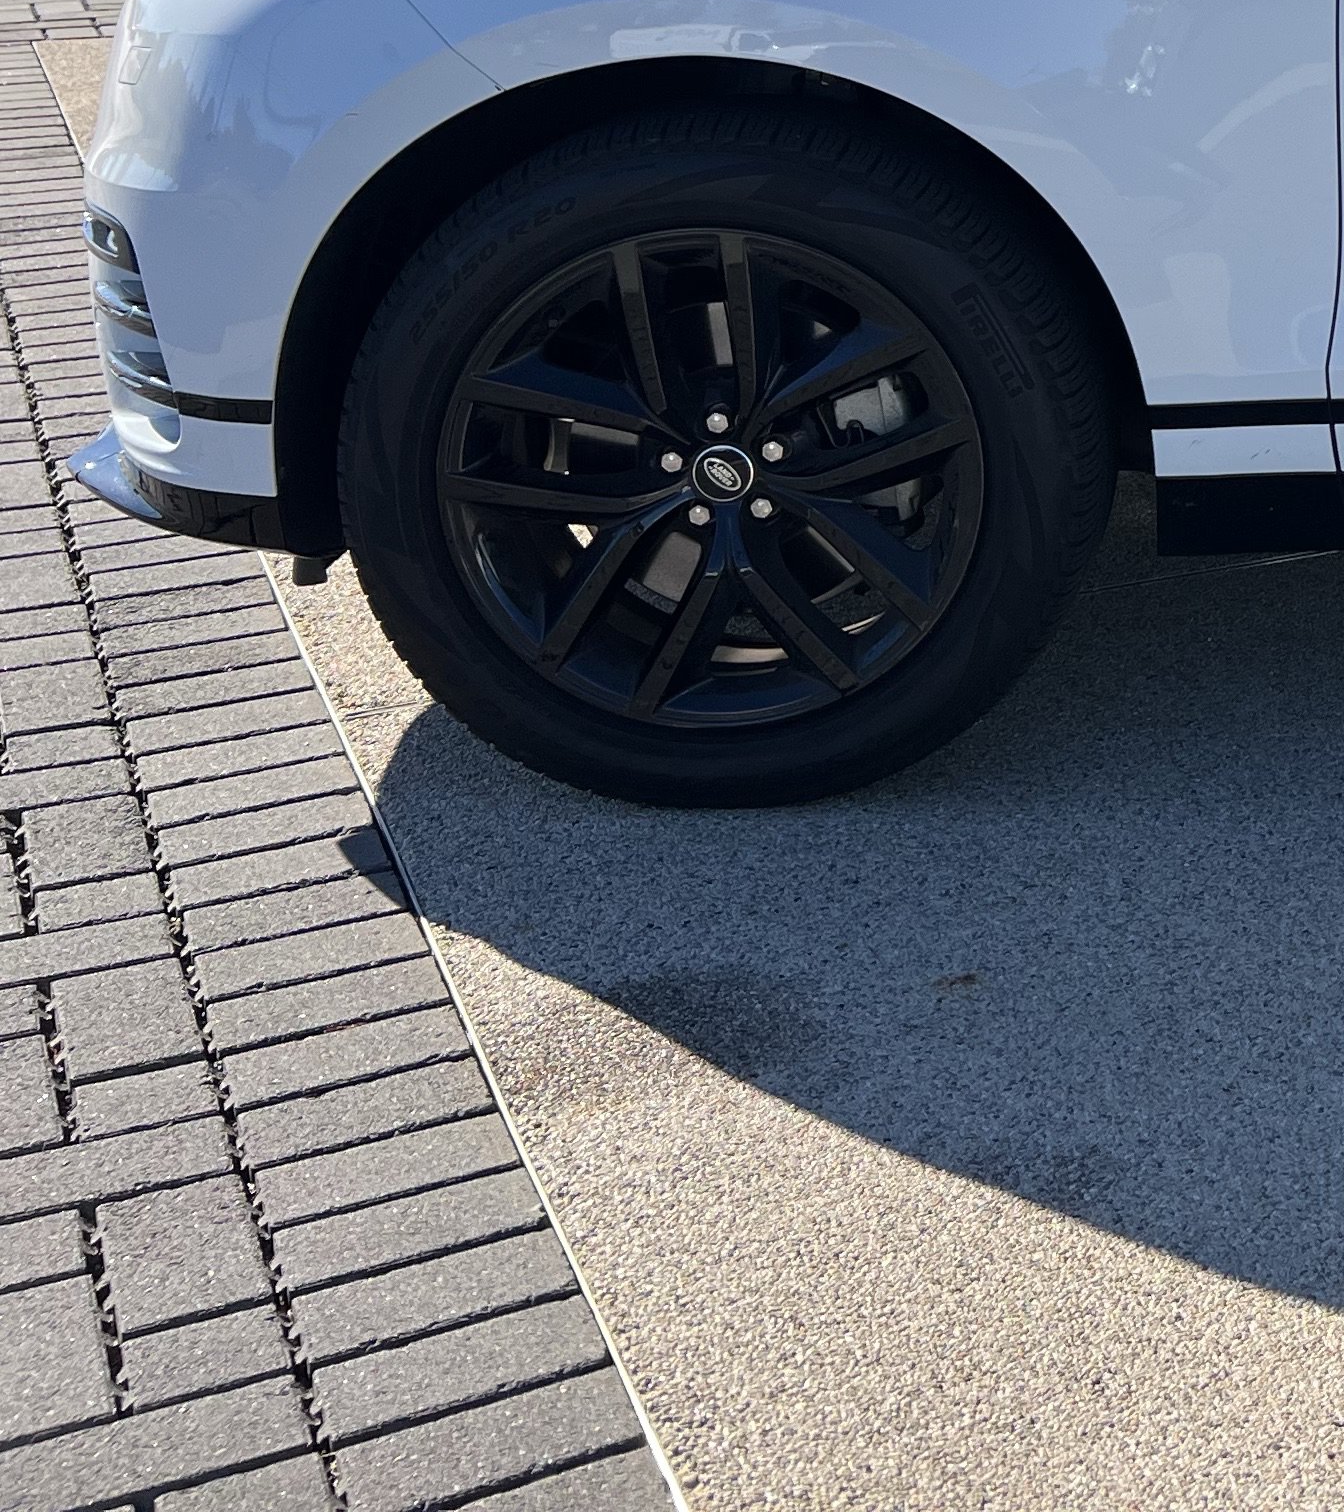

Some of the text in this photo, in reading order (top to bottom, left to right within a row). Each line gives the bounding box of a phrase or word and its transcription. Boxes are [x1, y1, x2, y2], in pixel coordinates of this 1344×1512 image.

[409, 197, 576, 343] 255/50 R20
[951, 282, 1034, 397] PIRELLI
